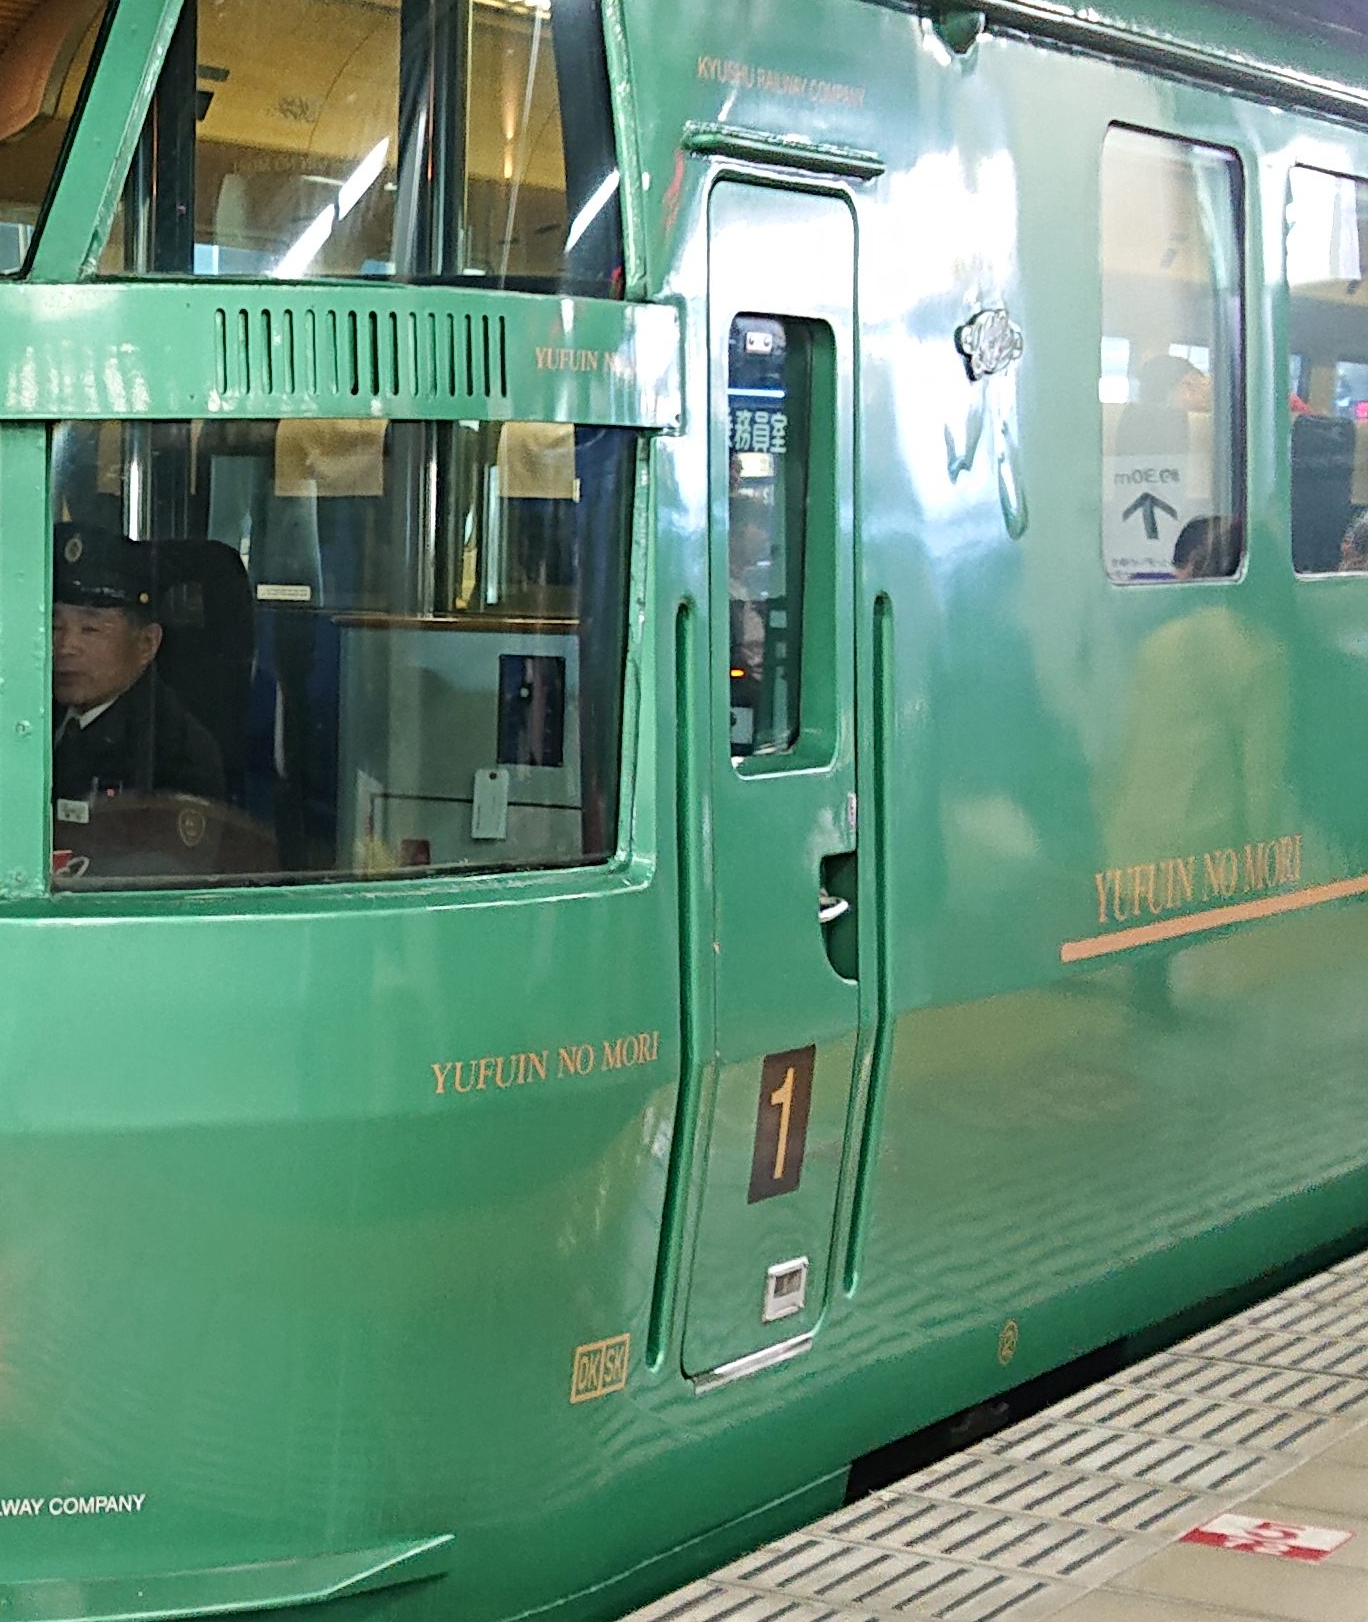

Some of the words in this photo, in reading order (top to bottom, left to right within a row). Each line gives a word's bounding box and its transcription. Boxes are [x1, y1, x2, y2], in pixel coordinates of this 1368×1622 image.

[535, 347, 598, 372] YUFUIN
[728, 409, 788, 454] 務員室
[1095, 856, 1196, 924] YUFUIN
[1203, 848, 1238, 902] NO
[1243, 833, 1303, 893] MORI
[431, 1050, 549, 1094] YUFUIN
[558, 1044, 595, 1078] NO
[601, 1031, 660, 1071] MORI
[771, 1067, 795, 1180] 1
[48, 1494, 146, 1516] COMPANY
